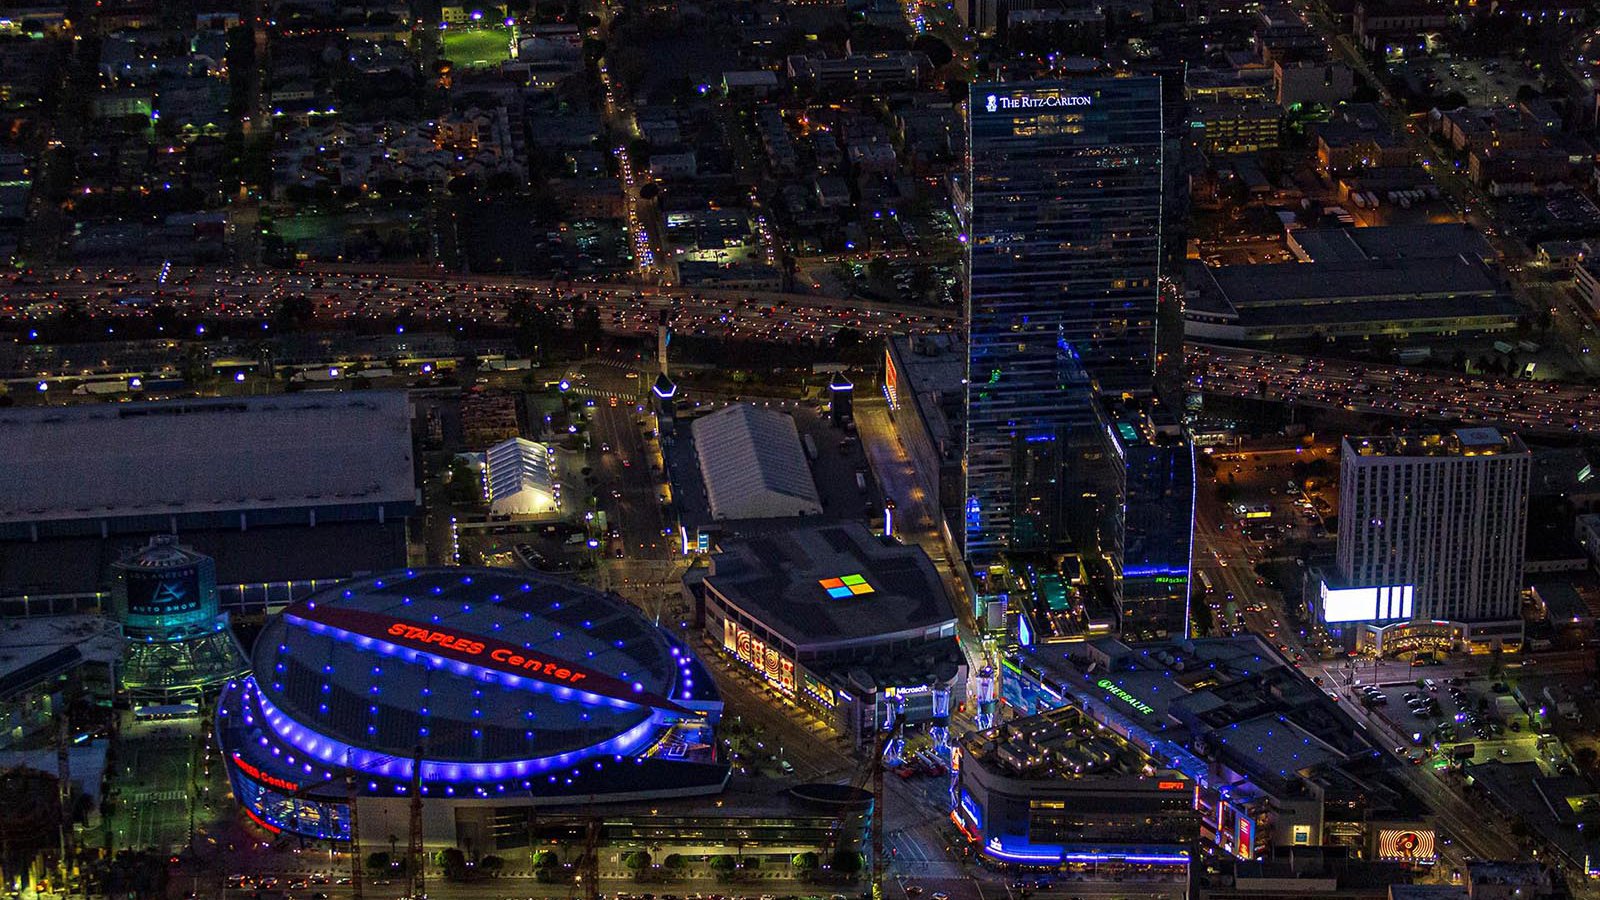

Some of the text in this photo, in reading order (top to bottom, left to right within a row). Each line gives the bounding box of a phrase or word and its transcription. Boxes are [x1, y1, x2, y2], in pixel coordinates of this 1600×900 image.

[1000, 95, 1091, 109] THE RITZ-CARLTON
[166, 602, 197, 612] SHOW
[387, 623, 586, 683] STAPLES Center
[896, 684, 928, 695] Microsoft
[1105, 684, 1154, 715] HERBALIFE
